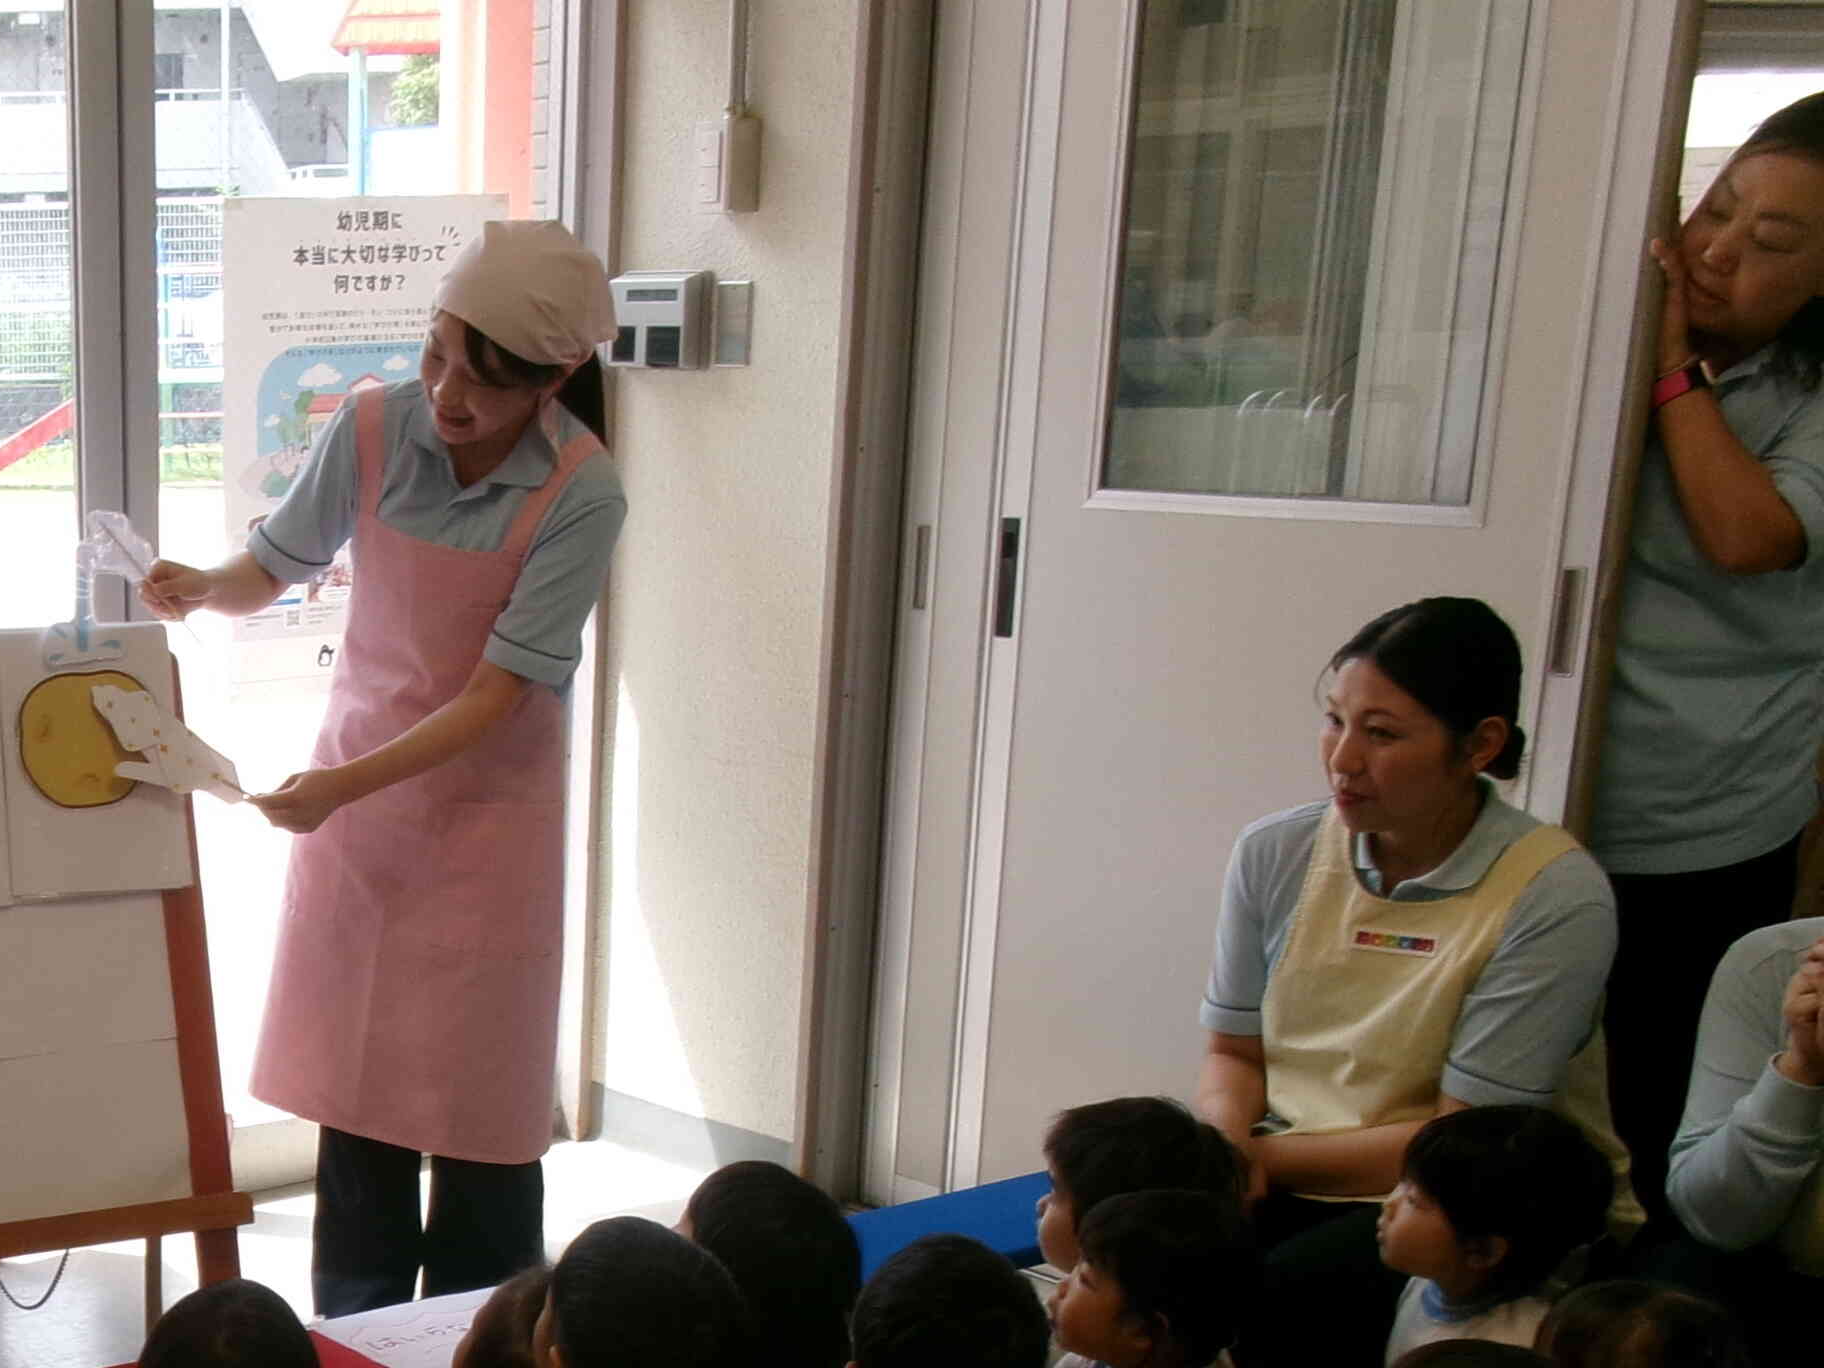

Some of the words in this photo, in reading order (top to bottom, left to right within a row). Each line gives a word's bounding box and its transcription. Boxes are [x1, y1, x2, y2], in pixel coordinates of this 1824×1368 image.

[336, 210, 403, 232] 幼児期に
[293, 245, 447, 267] 本当に大切な学びって
[334, 274, 407, 294] 何ですか？
